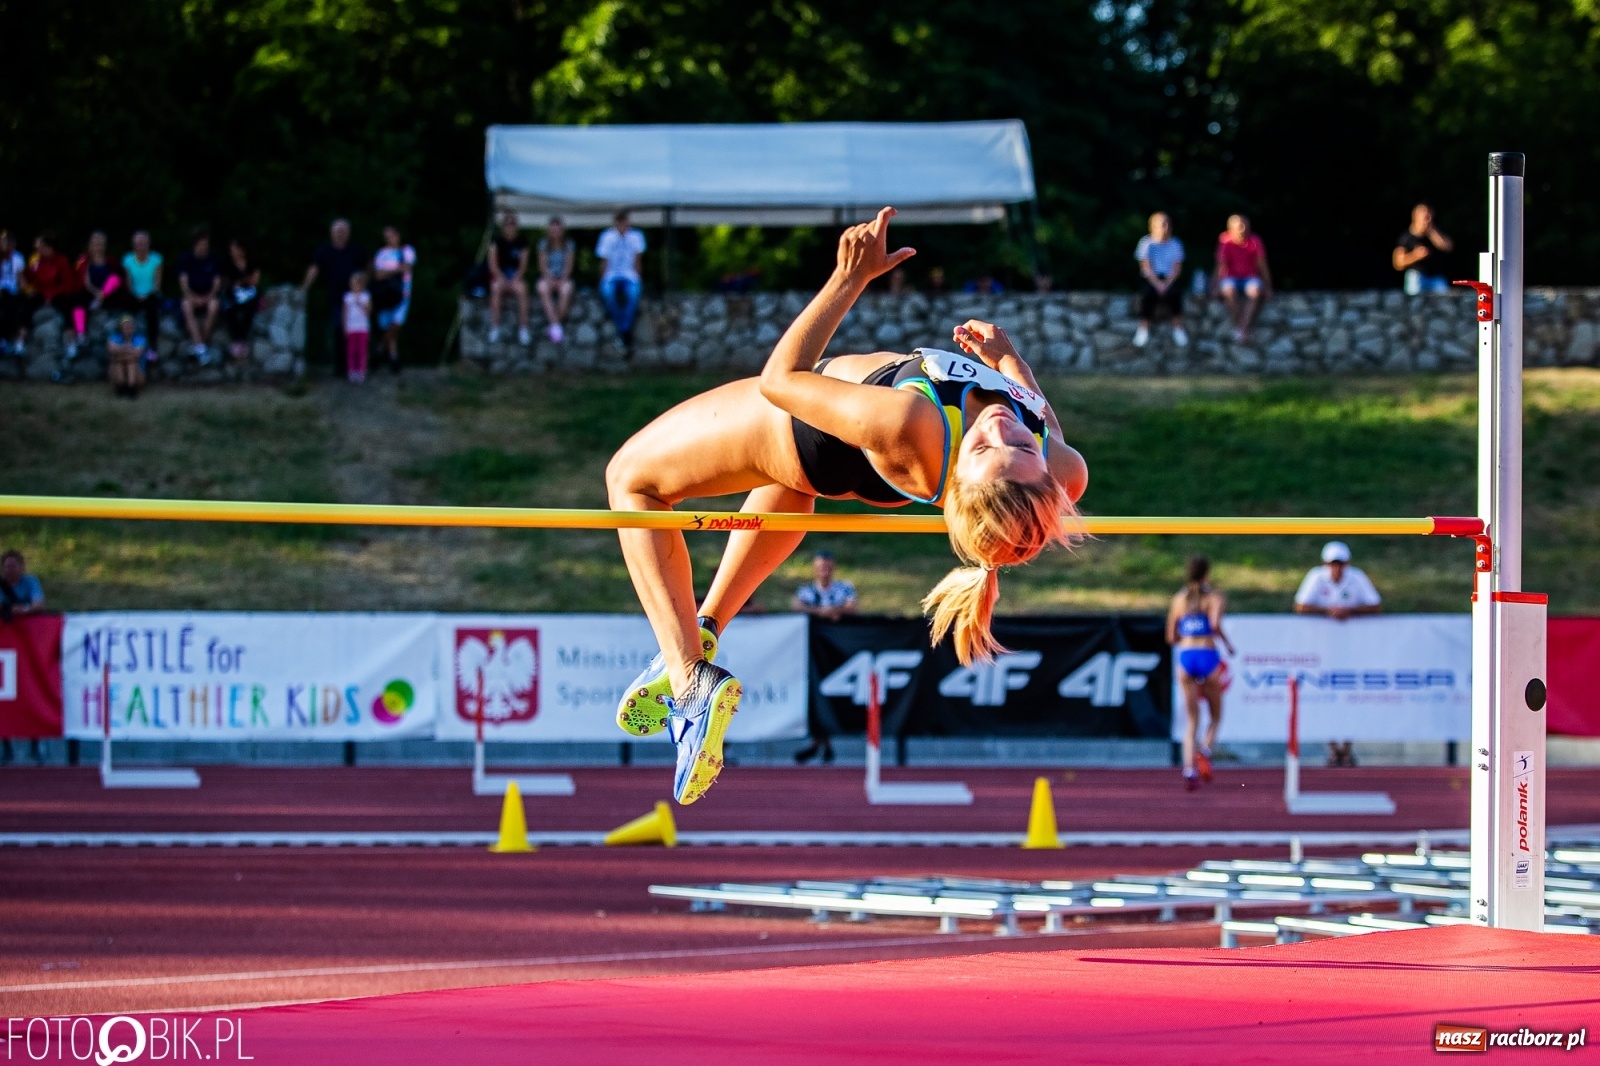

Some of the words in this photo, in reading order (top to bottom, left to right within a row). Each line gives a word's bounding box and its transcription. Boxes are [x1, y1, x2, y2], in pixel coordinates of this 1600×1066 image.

[947, 360, 977, 378] 67
[707, 515, 765, 530] polanik
[82, 623, 195, 674] NESTLÉ
[207, 637, 246, 673] for
[820, 649, 923, 706] 4F
[938, 650, 1043, 706] 4F
[1057, 652, 1162, 707] 4F
[1243, 669, 1455, 690] VANESSA
[82, 683, 269, 728] HEALTHIER
[287, 683, 362, 727] KIDS
[1516, 781, 1530, 852] polanik
